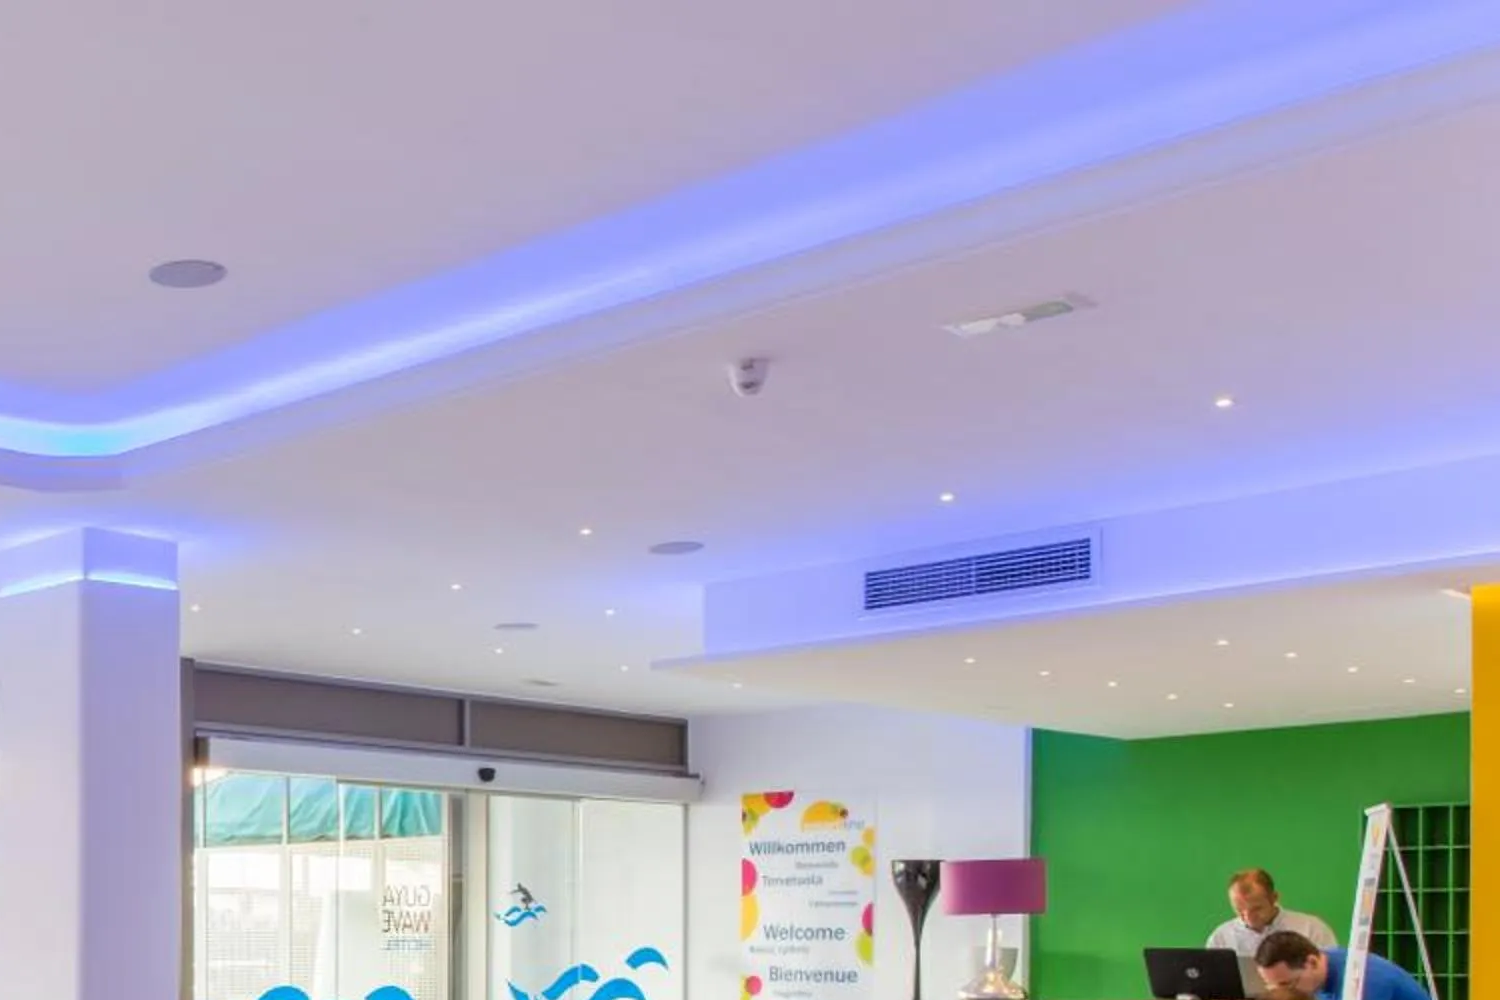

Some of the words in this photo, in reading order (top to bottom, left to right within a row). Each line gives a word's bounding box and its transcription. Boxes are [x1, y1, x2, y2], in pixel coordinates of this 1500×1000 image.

[749, 839, 846, 856] Willkommen
[763, 923, 846, 941] Welcome
[769, 965, 859, 983] Bienvenue
